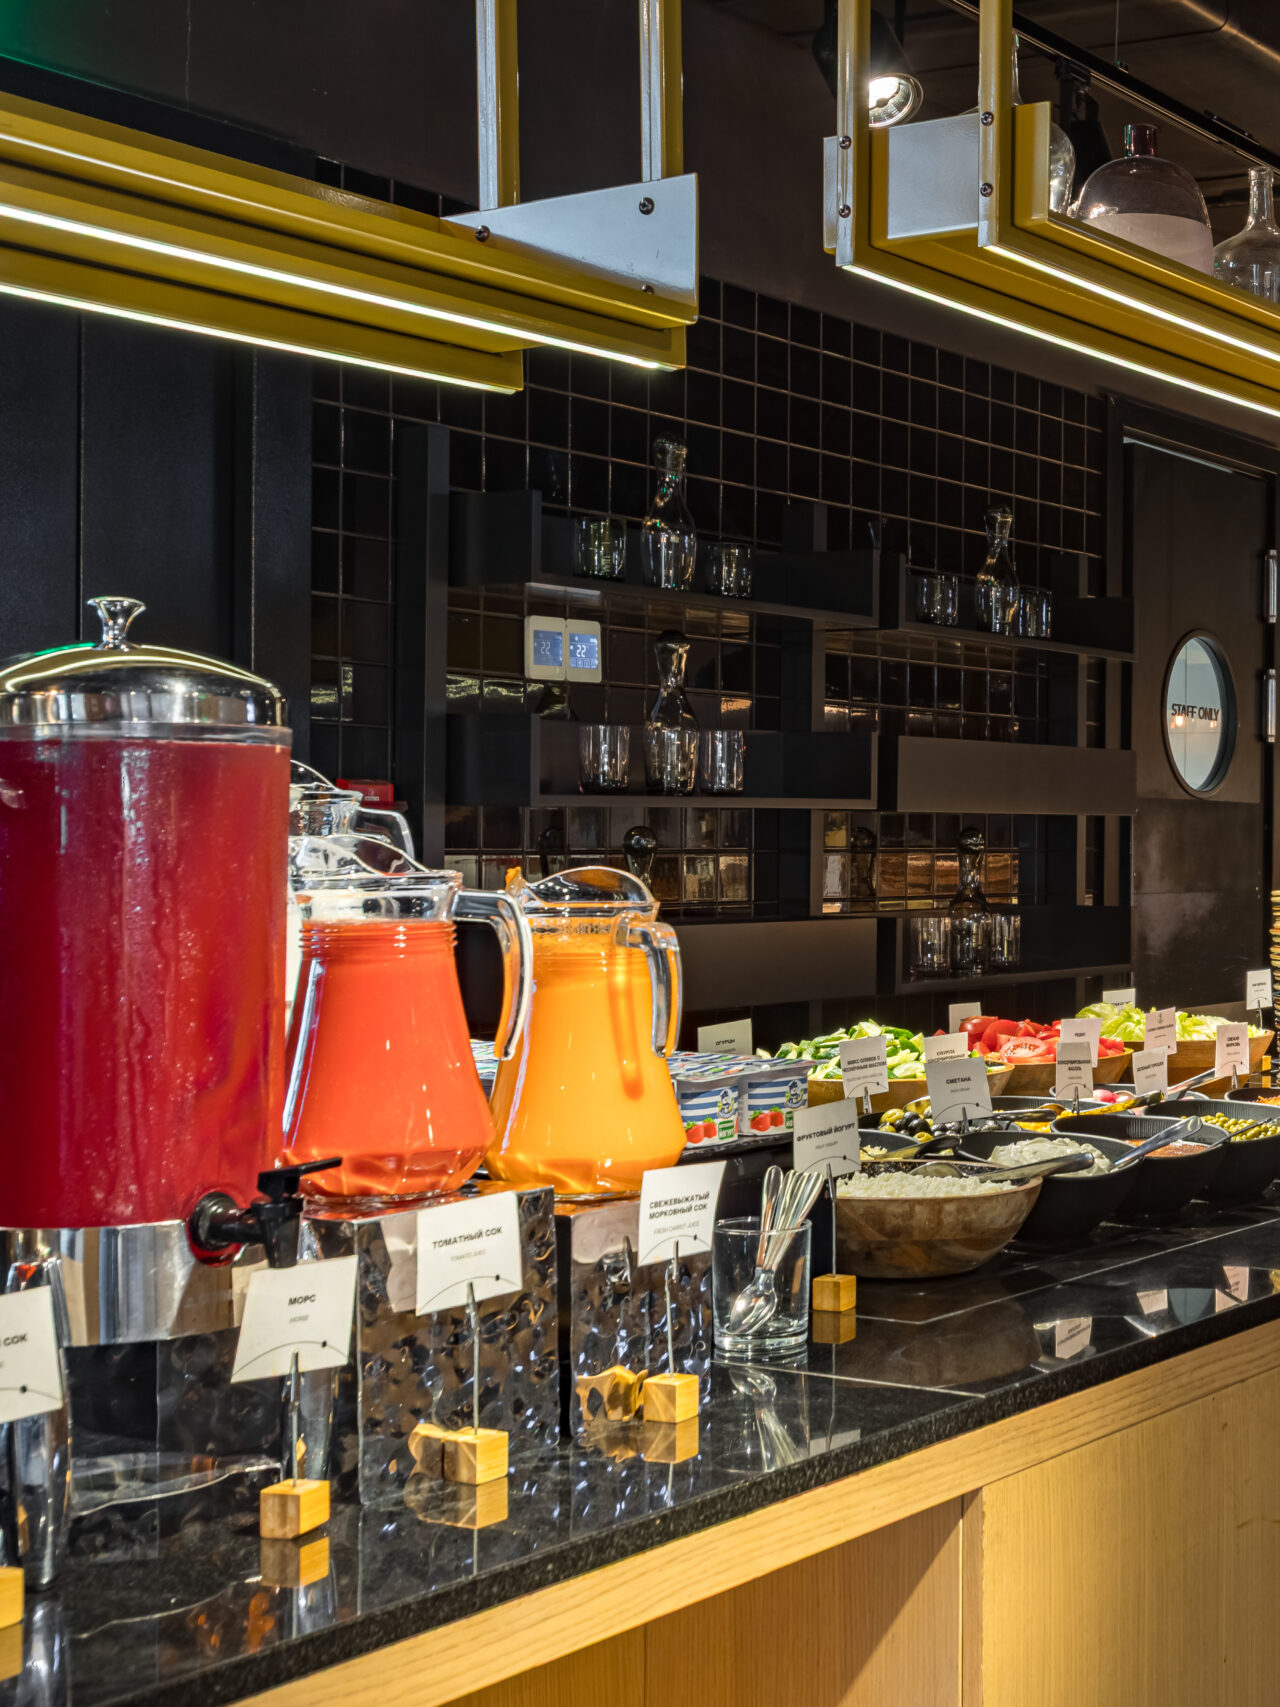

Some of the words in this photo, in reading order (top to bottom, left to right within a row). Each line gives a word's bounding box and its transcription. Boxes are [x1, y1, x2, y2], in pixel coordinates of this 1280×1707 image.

[576, 644, 587, 658] 22
[1171, 703, 1197, 718] STAFF
[1198, 706, 1220, 721] ONLY
[945, 1076, 971, 1084] СМЕТАНА
[797, 1127, 832, 1141] ФРУКТОВЫЙ
[833, 1122, 855, 1133] ЙОГУРТ
[649, 1190, 710, 1209] СВЕЖЕВЫЖАТЫЙ
[649, 1205, 692, 1219] МОРКОВНЫЙ
[693, 1203, 708, 1211] СОК
[432, 1229, 483, 1249] ТОМАТНЫЙ
[485, 1226, 503, 1237] СОК
[288, 1295, 316, 1305] МОРС
[3, 1333, 27, 1346] СОК
